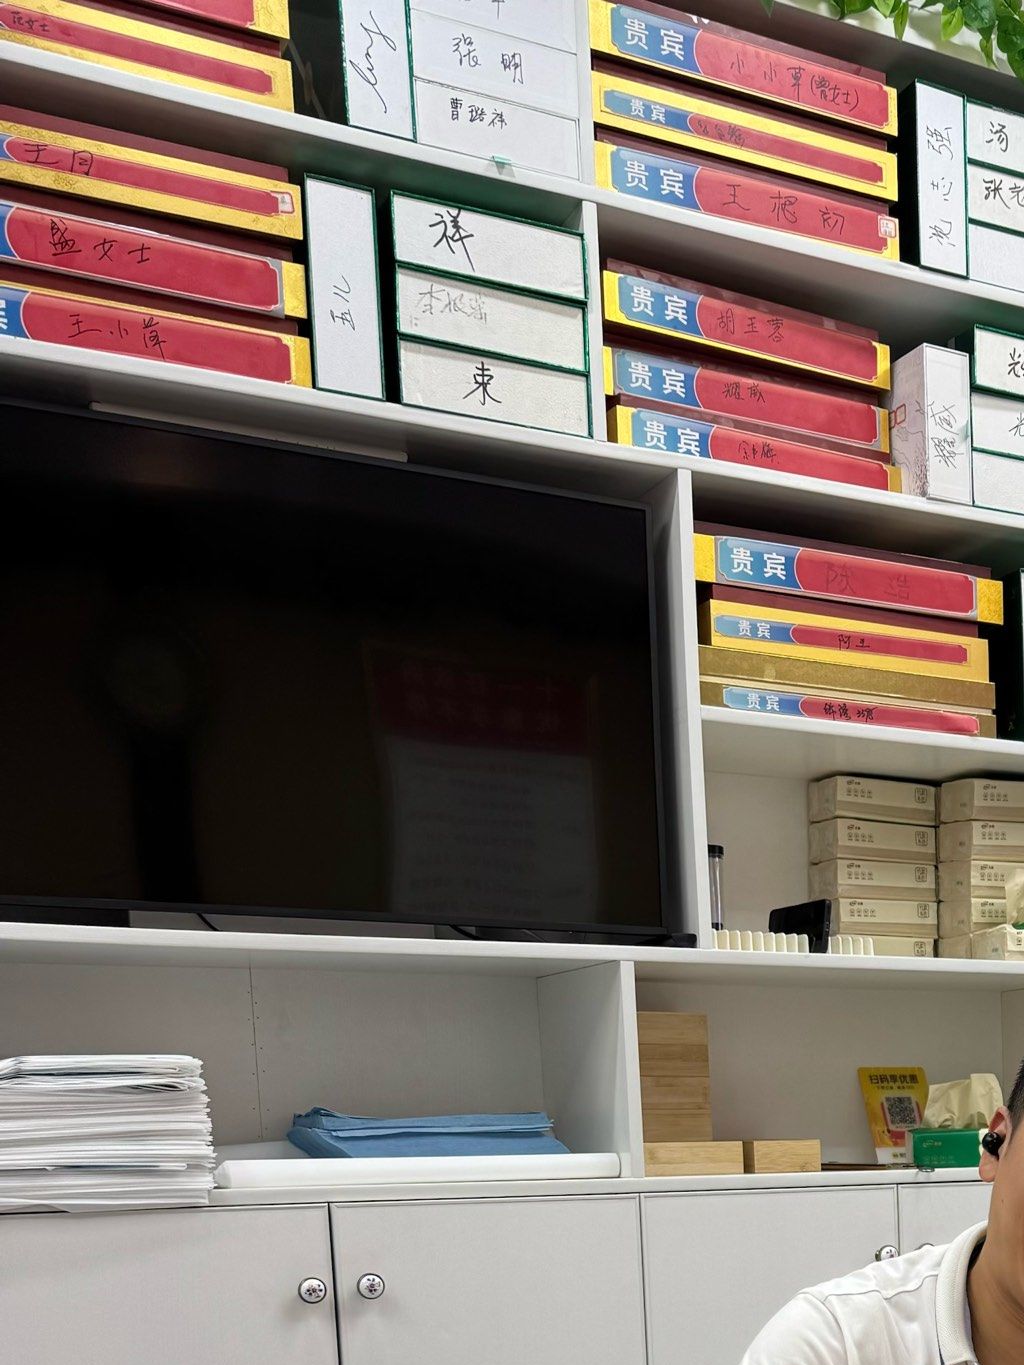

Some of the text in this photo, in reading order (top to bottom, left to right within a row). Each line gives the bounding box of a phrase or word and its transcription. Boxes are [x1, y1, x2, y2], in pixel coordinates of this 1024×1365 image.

[623, 18, 685, 60] 贵宾
[629, 99, 667, 123] 贵宾
[623, 160, 685, 199] 贵宾
[429, 208, 475, 273] 祥
[630, 285, 688, 325] 贵宾
[628, 361, 686, 398] 贵宾
[643, 420, 700, 458] 贵宾
[730, 547, 787, 581] 贵宾
[737, 619, 771, 639] 贵宾
[746, 693, 780, 712] 贵宾
[868, 1073, 920, 1085] 扫码享优惠
